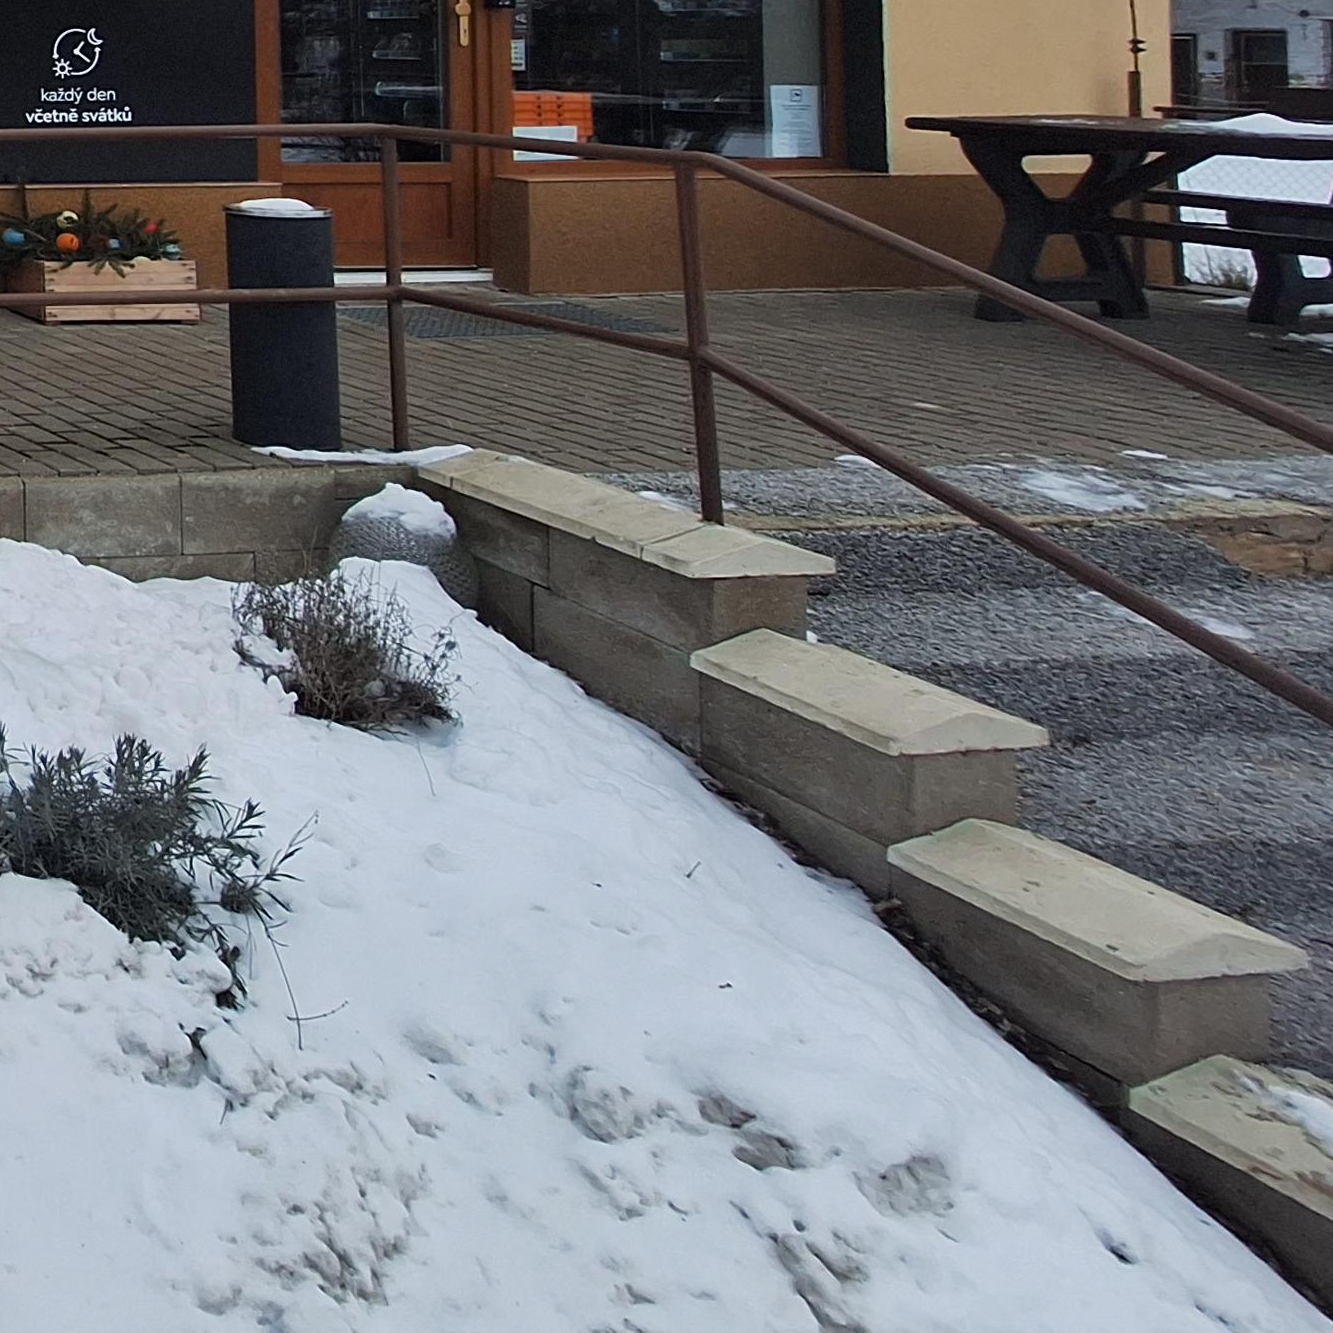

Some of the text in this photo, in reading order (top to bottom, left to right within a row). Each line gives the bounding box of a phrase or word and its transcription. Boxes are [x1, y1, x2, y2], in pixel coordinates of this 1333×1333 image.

[40, 87, 116, 104] každý den
[25, 106, 133, 123] včetně svátků
